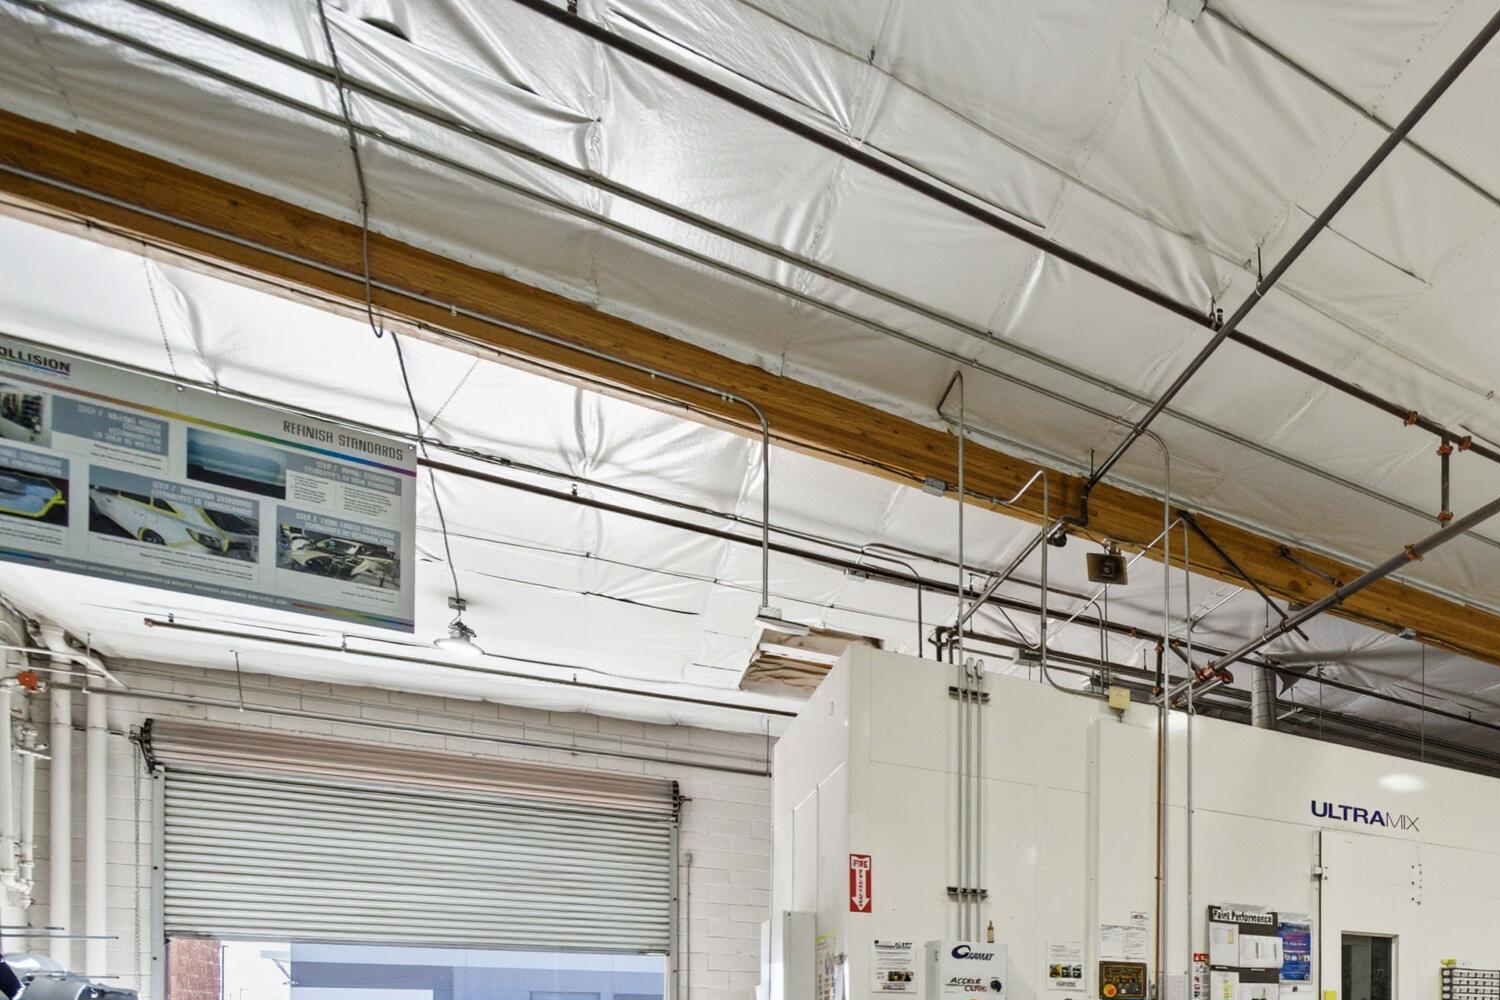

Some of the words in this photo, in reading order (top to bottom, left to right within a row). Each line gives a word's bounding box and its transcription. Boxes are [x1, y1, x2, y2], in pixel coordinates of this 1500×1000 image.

[283, 420, 333, 443] REFINISH
[338, 434, 403, 461] STANDARDS
[1311, 800, 1419, 832] ULTRAMIX
